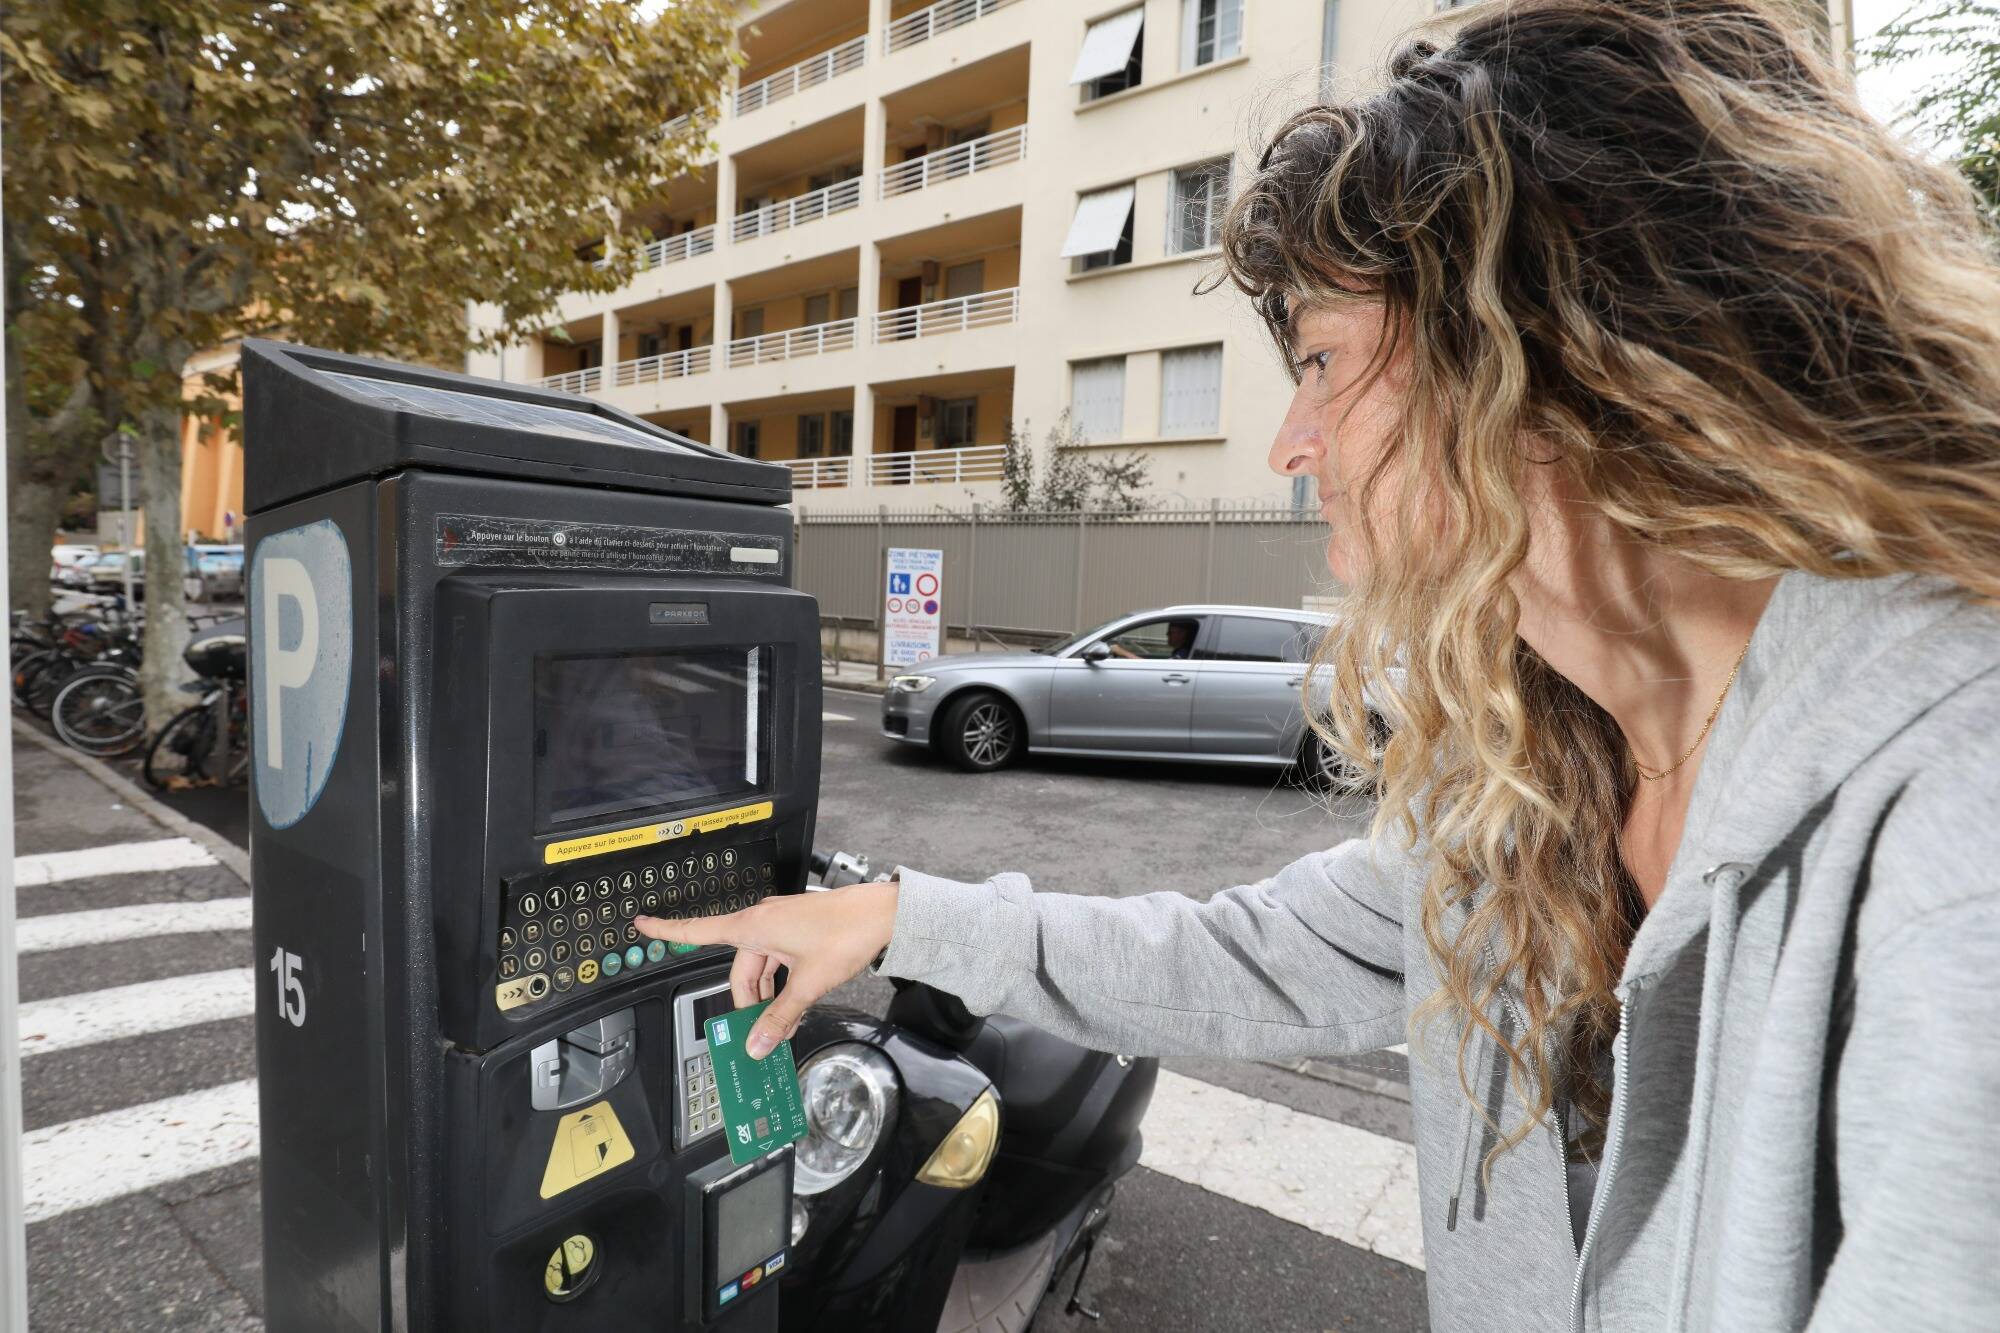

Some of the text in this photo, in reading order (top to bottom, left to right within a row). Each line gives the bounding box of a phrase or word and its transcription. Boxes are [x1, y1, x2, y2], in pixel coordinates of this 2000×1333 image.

[471, 531, 501, 542] Appuyer
[503, 533, 514, 541] sur
[524, 533, 549, 543] bouton
[603, 538, 623, 547] clavier
[263, 558, 320, 771] P
[556, 843, 592, 856] Appuyez
[594, 840, 607, 848] sur
[608, 838, 616, 846] le
[618, 833, 644, 844] bouton
[701, 817, 724, 827] laissez
[725, 814, 740, 822] vous
[740, 809, 759, 820] guider
[501, 932, 513, 945] A
[527, 925, 538, 940] B
[553, 919, 564, 932] C
[578, 913, 588, 926] D
[625, 901, 634, 914] F
[646, 895, 657, 907] G
[667, 890, 677, 903] H
[727, 875, 736, 887] K
[524, 852, 733, 913] 0 1 2 3 4 5 6 7 8 9
[503, 959, 515, 975] N
[529, 952, 542, 967] O
[556, 947, 566, 960] P
[580, 939, 592, 952] Q
[604, 932, 615, 946] R
[627, 926, 637, 939] S
[708, 903, 720, 916] W
[729, 898, 738, 911] X
[747, 893, 755, 905] Y
[270, 946, 306, 1028] 15
[768, 1257, 782, 1270] VISA
